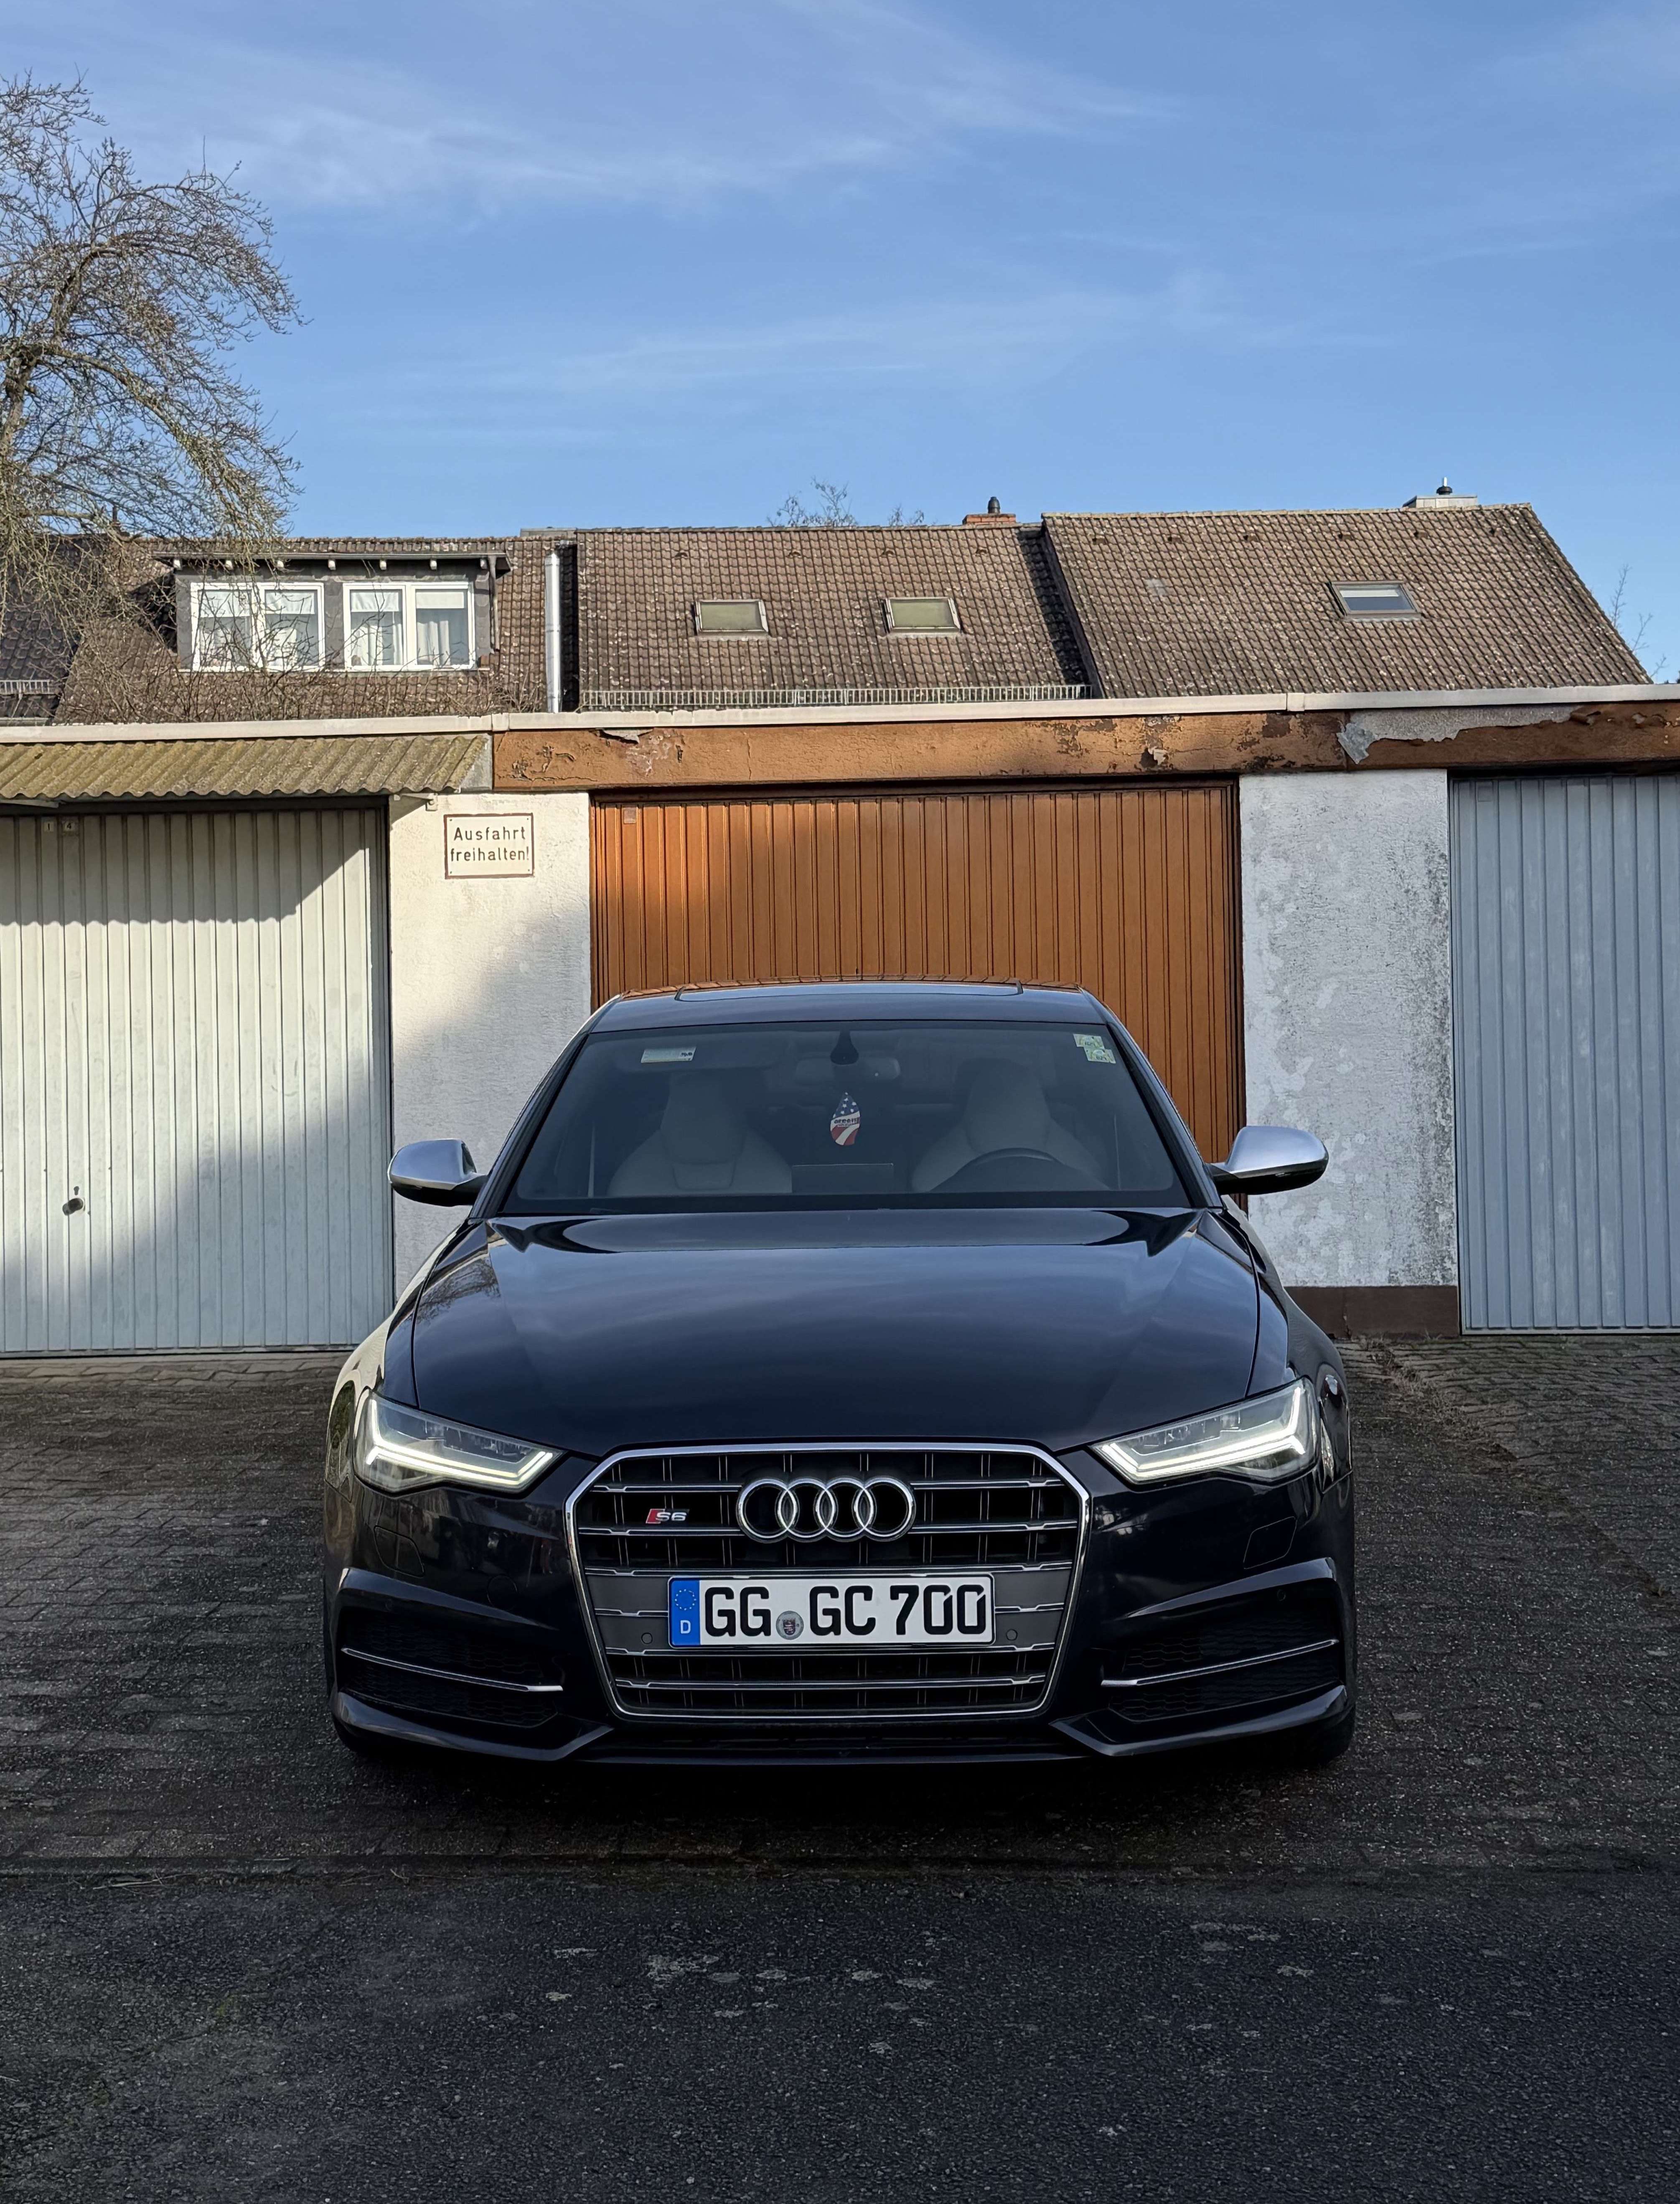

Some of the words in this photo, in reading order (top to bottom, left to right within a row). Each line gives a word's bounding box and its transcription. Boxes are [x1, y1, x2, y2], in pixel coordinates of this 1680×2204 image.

[454, 826, 526, 841] Ausfahrt
[450, 846, 529, 862] freihalten!
[655, 1512, 687, 1521] S6
[705, 1586, 771, 1637] GG
[809, 1585, 876, 1636] GC
[890, 1584, 986, 1635] 700
[680, 1620, 691, 1634] D
